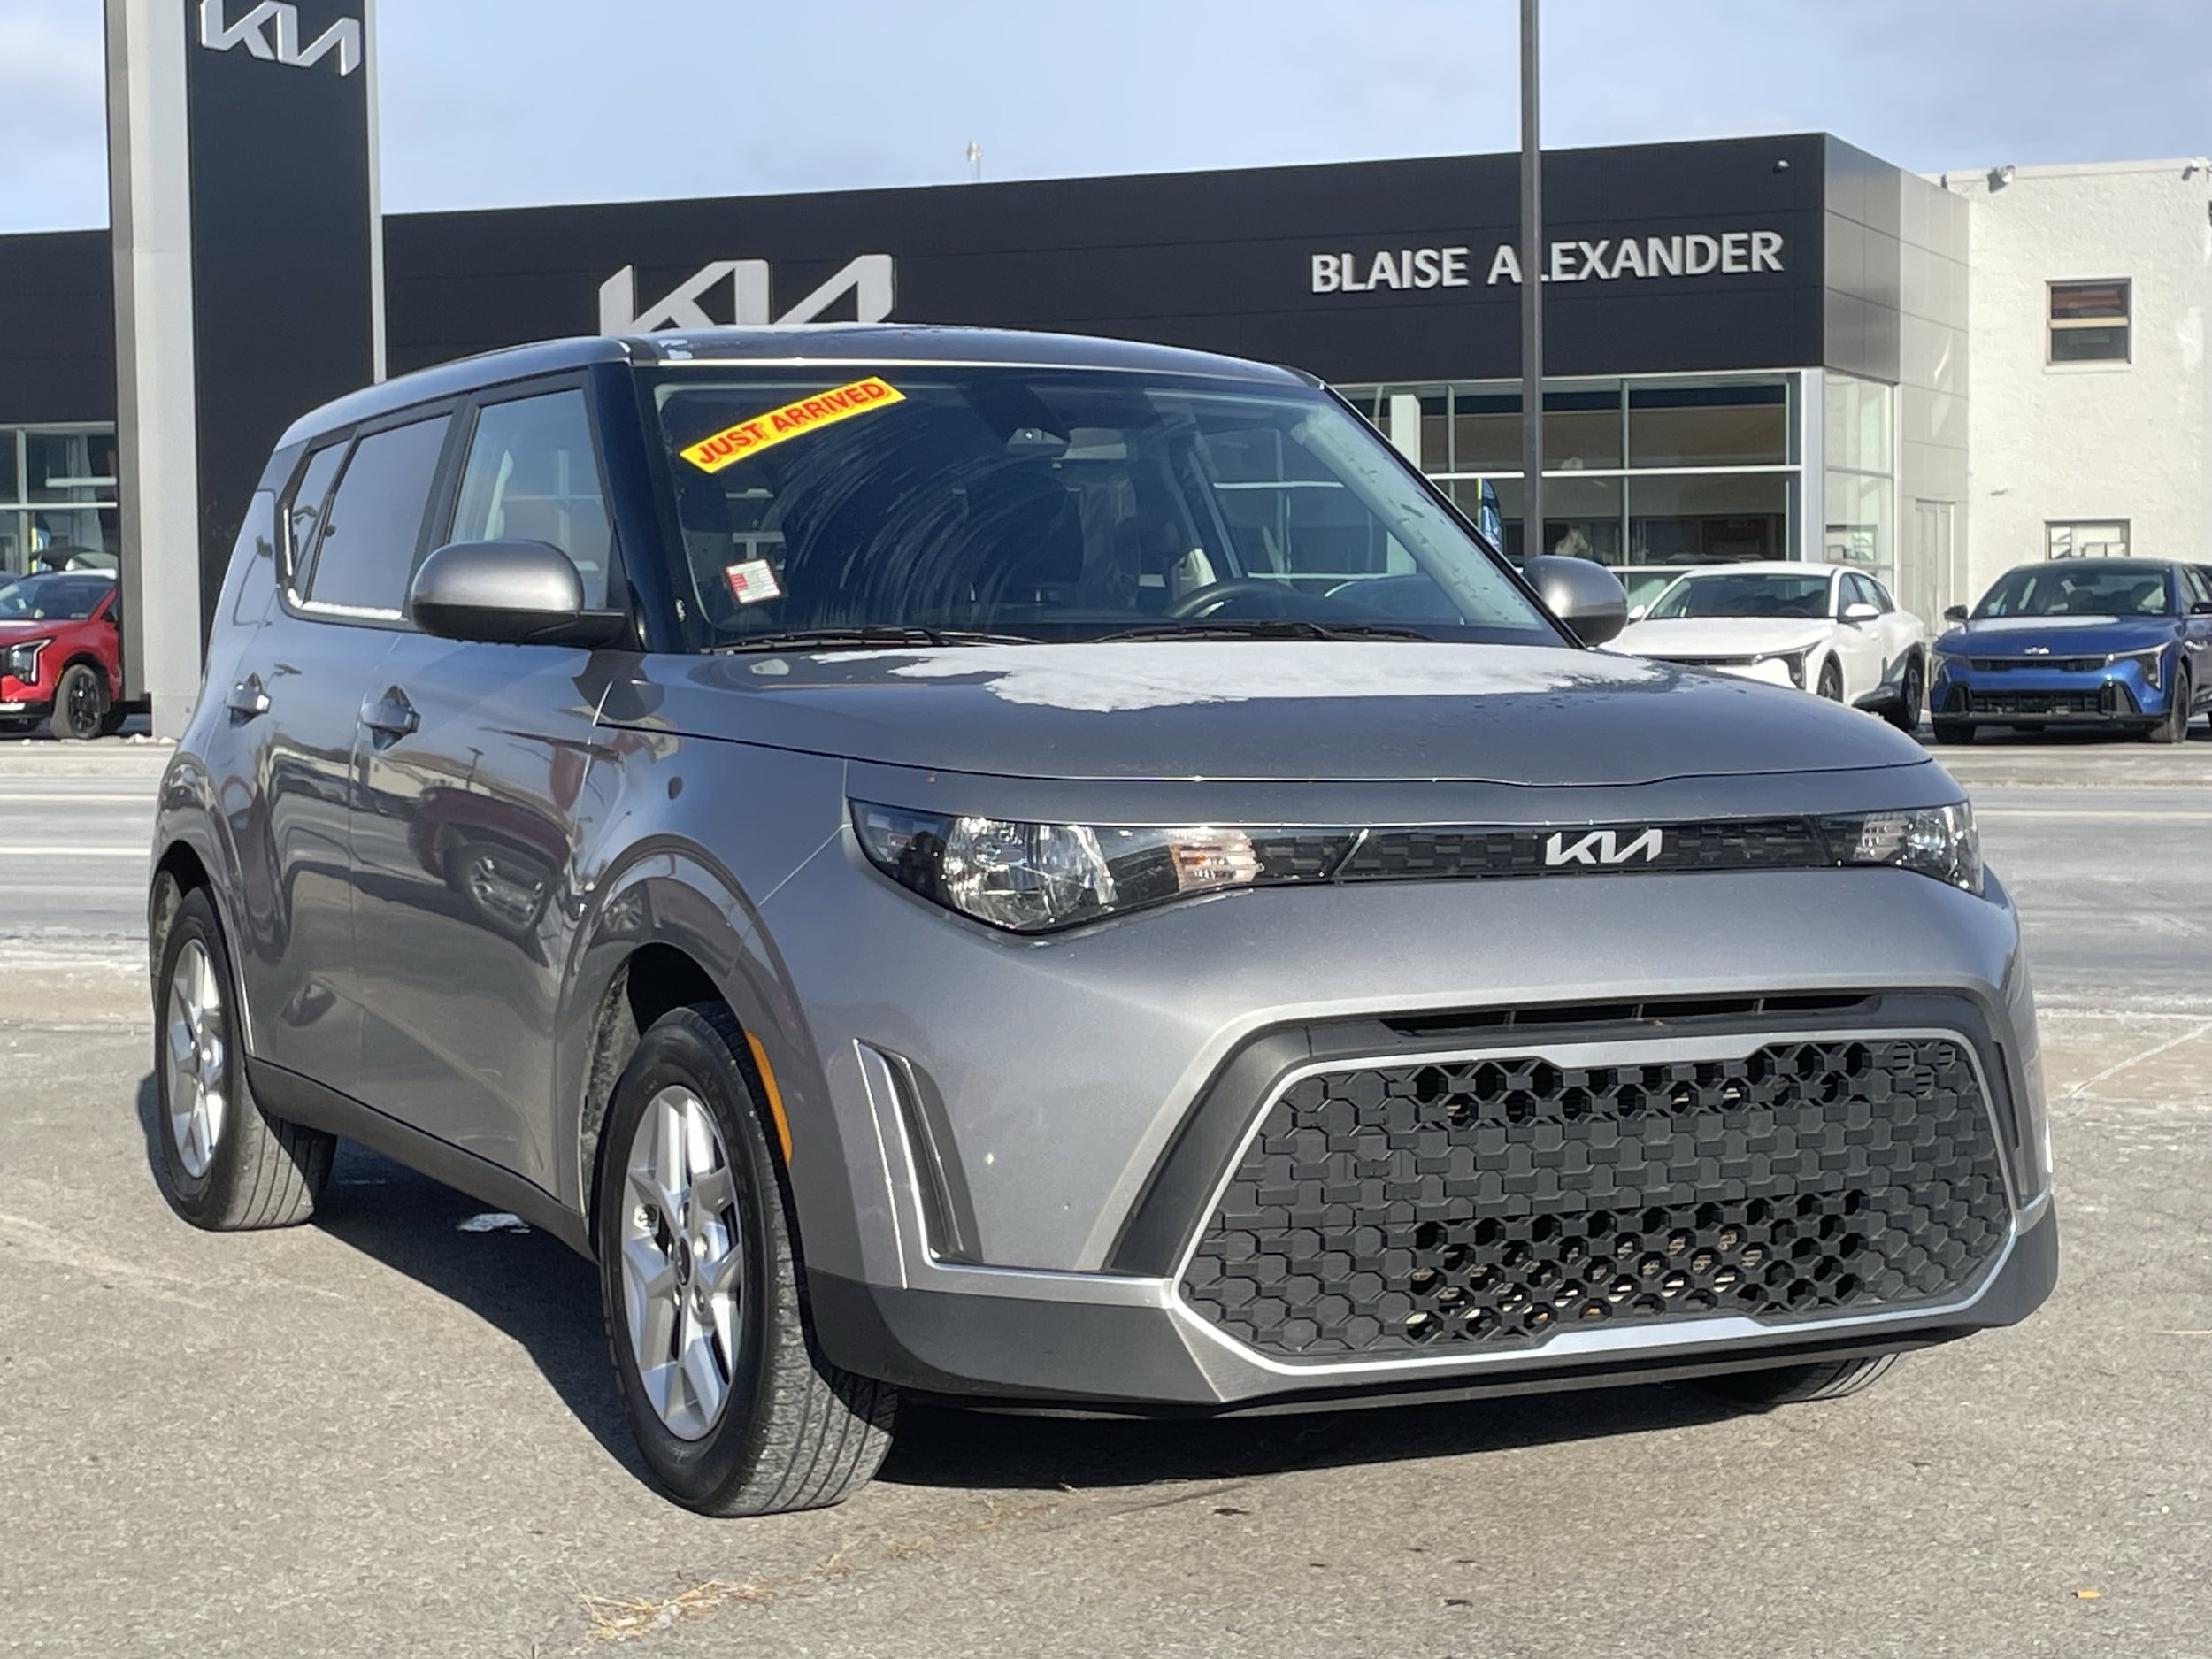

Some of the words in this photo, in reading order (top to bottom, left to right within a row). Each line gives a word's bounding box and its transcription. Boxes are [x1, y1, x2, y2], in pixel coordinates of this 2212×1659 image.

[200, 0, 361, 77] KIA
[599, 253, 894, 337] KIA
[1311, 247, 1470, 293] BLAISE
[1487, 230, 1784, 285] AEXANDER
[698, 422, 764, 465] JUST
[769, 382, 892, 434] ARRIVED
[1545, 828, 1663, 865] KIA
